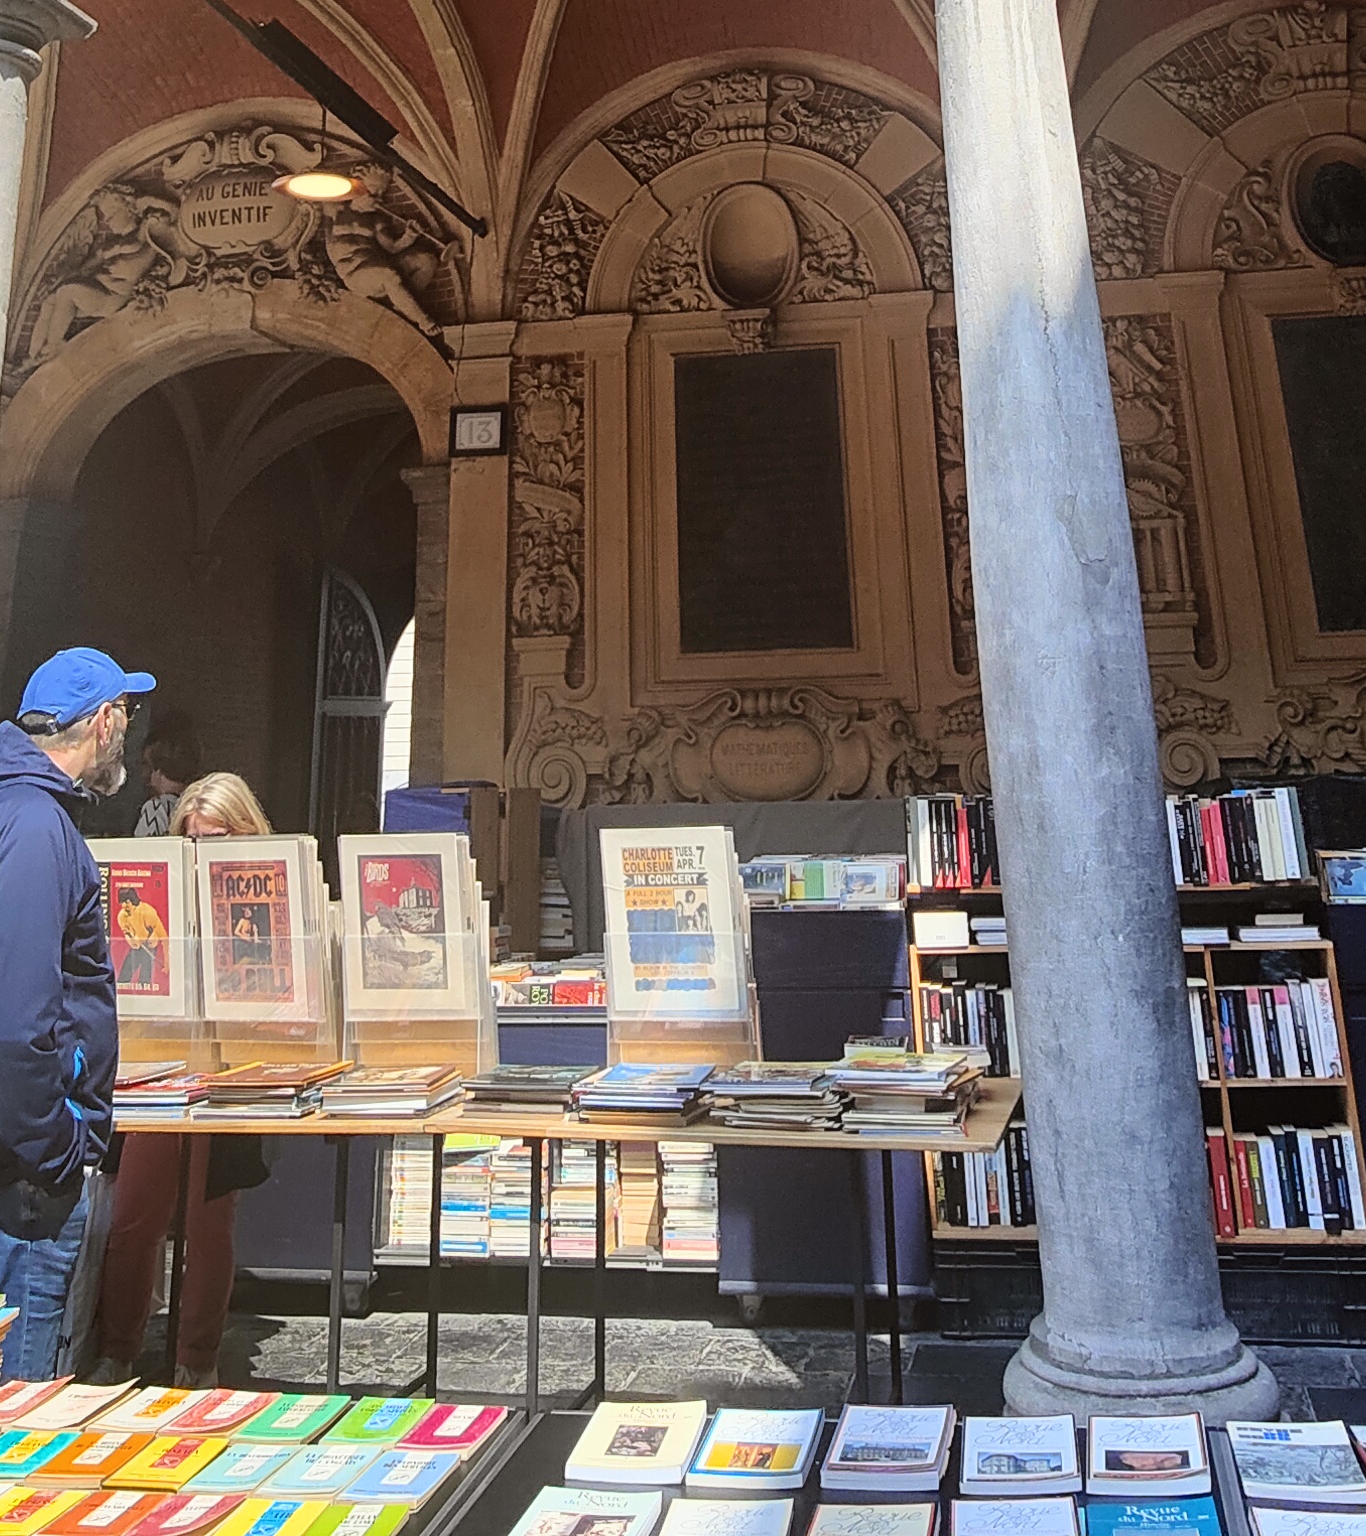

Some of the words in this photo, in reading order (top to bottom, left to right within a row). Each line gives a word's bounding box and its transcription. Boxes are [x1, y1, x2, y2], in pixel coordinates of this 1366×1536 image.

[196, 183, 217, 202] AU
[192, 205, 274, 229] INVENTIF
[468, 420, 493, 446] 13
[622, 848, 674, 861] CHARLOTTE
[675, 846, 696, 857] TUES.
[695, 845, 705, 865] 7
[366, 862, 389, 882] BIRDS
[623, 861, 675, 873] COLISEUM
[676, 859, 697, 870] APR.
[633, 874, 646, 885] IN
[649, 873, 699, 885] CONCERT
[630, 1405, 673, 1414] Revue
[637, 1411, 676, 1419] Nord
[577, 1491, 625, 1501] Revue
[587, 1498, 629, 1509] Nord
[1117, 1515, 1136, 1523] du
[1140, 1510, 1189, 1523] Nord
[1125, 1505, 1181, 1517] Revue
